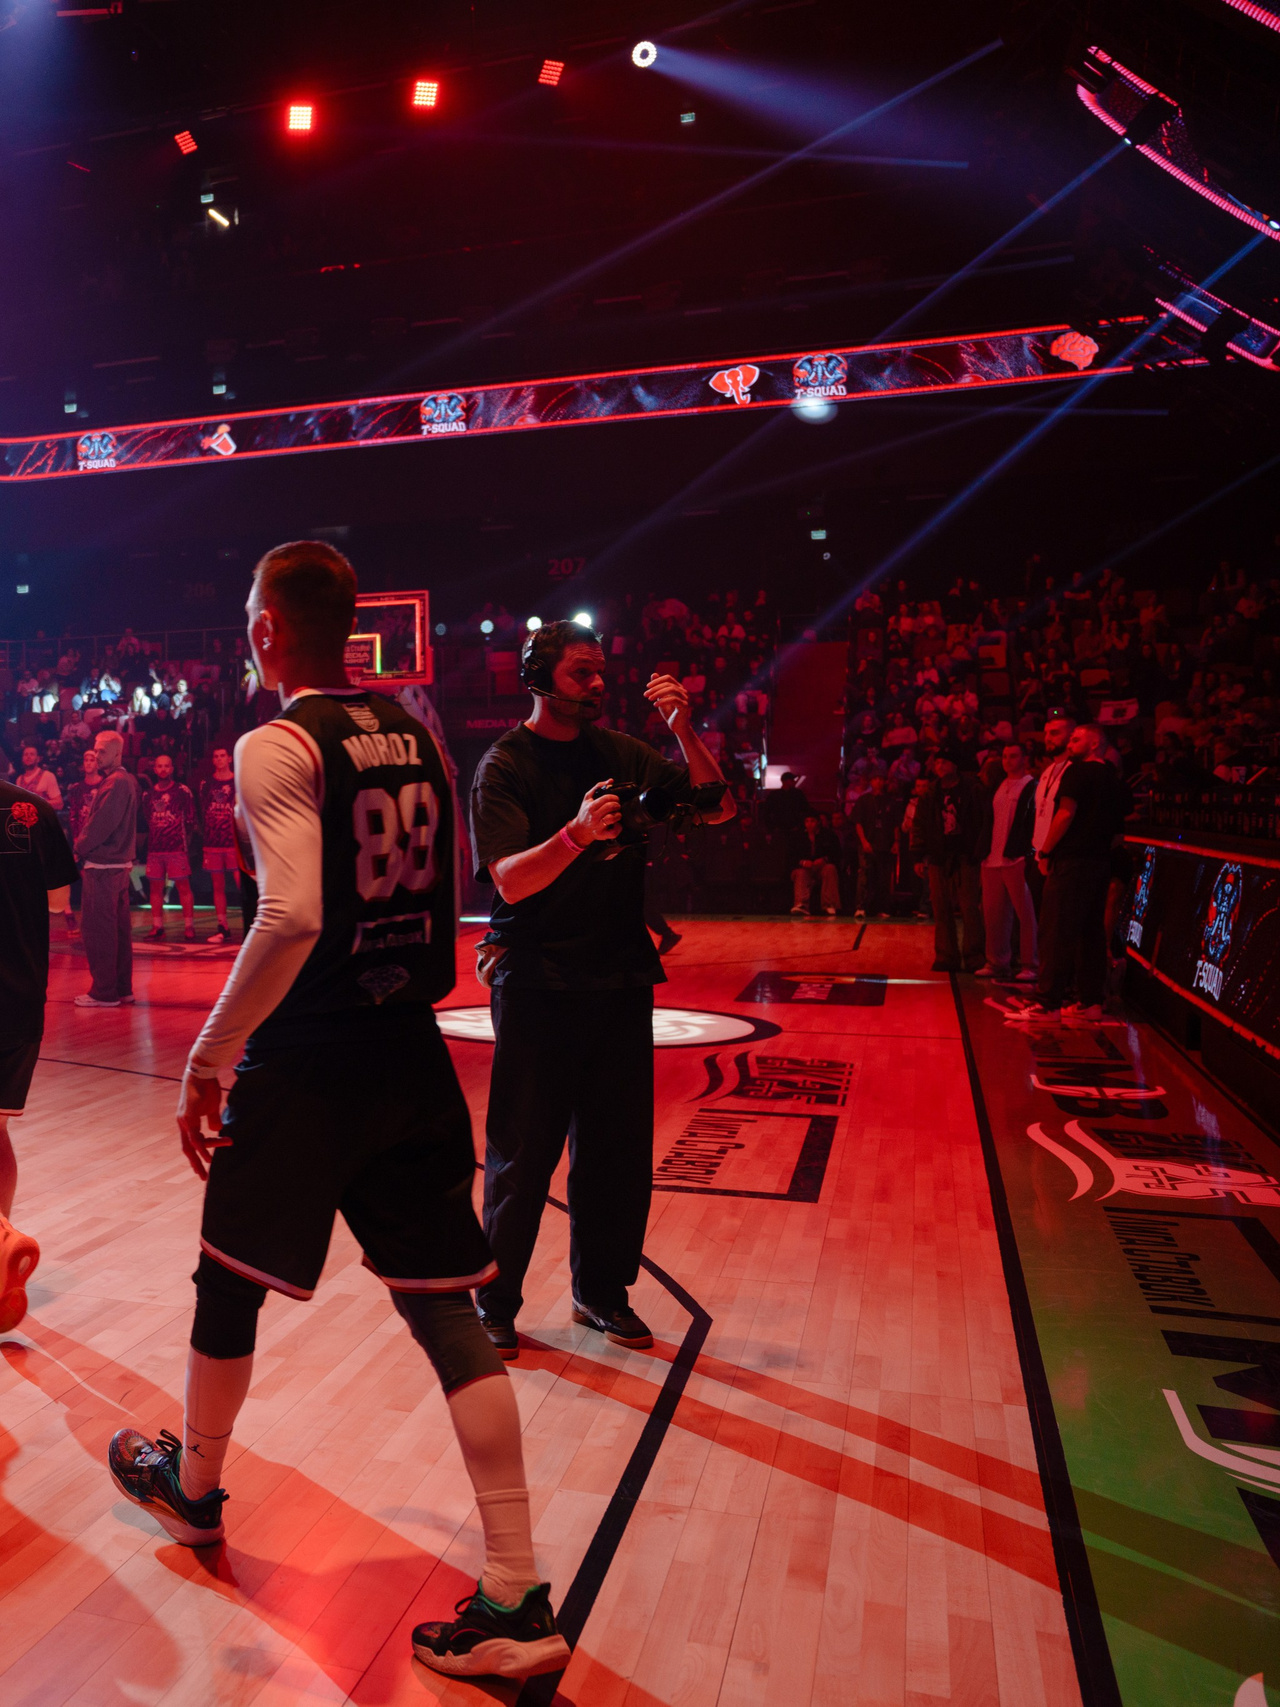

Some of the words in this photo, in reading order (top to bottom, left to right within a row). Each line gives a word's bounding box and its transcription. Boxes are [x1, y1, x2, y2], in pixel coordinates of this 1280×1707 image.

[794, 384, 847, 400] T-SQUAD
[422, 421, 466, 436] T-SQUAD
[78, 457, 116, 471] T-SQUAD
[342, 732, 423, 773] MOROZ
[352, 781, 440, 902] 88
[1192, 960, 1224, 1002] T-SQUAD
